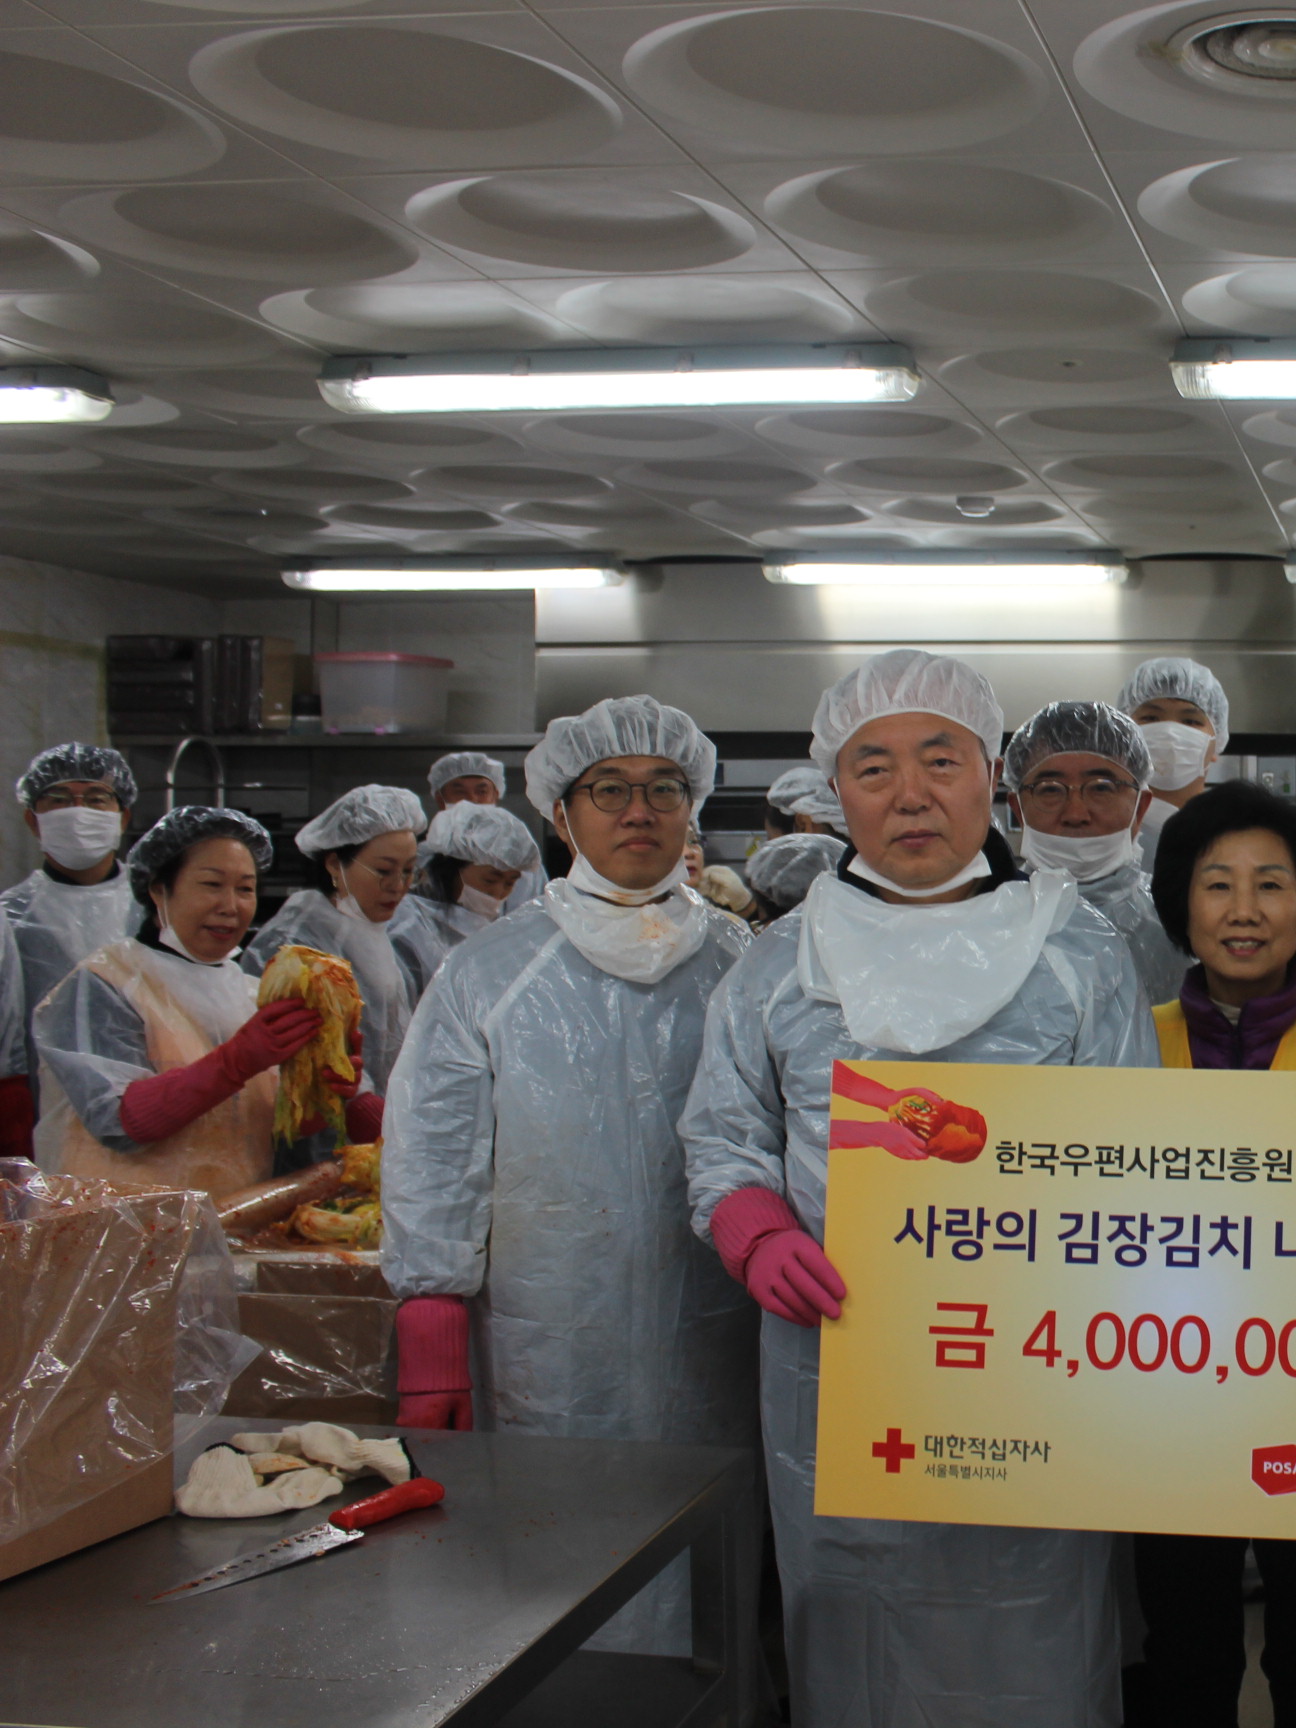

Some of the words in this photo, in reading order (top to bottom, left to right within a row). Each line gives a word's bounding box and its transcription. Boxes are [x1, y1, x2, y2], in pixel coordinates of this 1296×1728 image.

[994, 1140, 1294, 1183] 한국우편사업진흥원
[893, 1205, 1038, 1262] 사랑의
[1056, 1211, 1253, 1269] 김장김치
[928, 1302, 995, 1369] 금
[924, 1434, 1052, 1462] 대한적십자사
[924, 1463, 1008, 1481] 서울특별시지사
